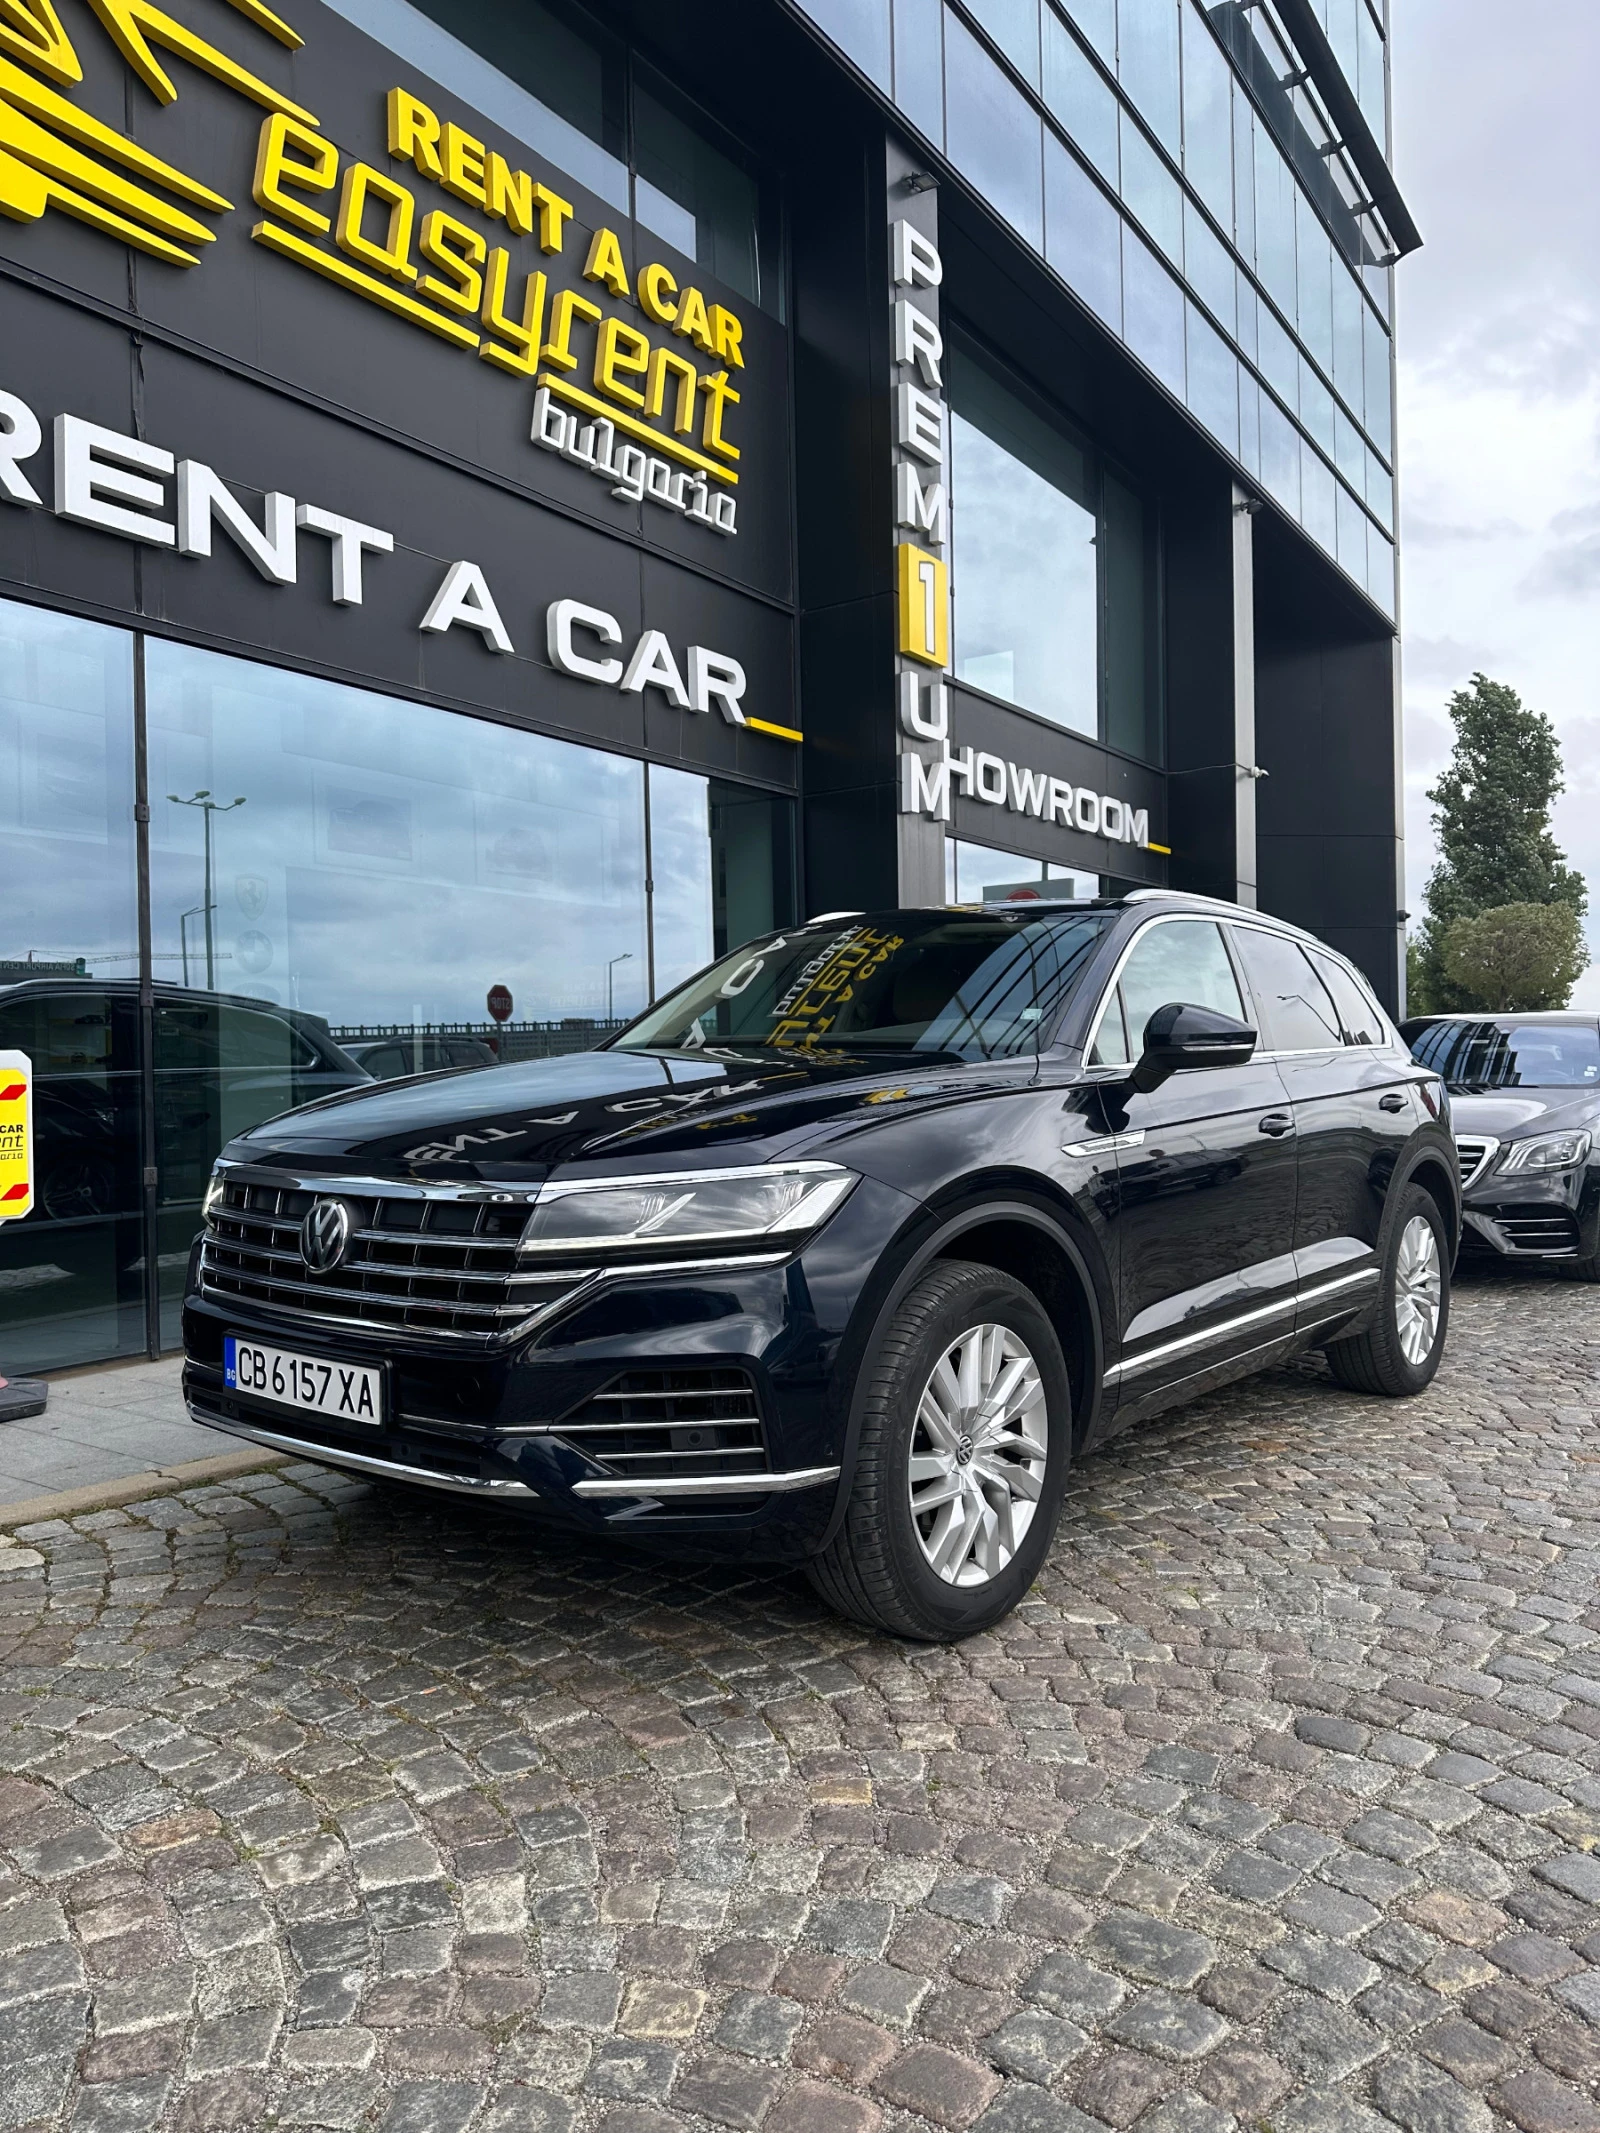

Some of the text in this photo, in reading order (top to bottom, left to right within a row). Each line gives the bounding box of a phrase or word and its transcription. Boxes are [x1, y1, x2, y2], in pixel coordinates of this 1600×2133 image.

[252, 112, 741, 461] easyrent
[387, 86, 746, 368] RENT A CAR
[530, 387, 738, 536] bulgaria
[419, 560, 515, 655] A
[547, 599, 748, 726] CAR
[944, 738, 1149, 848] HOWROOM
